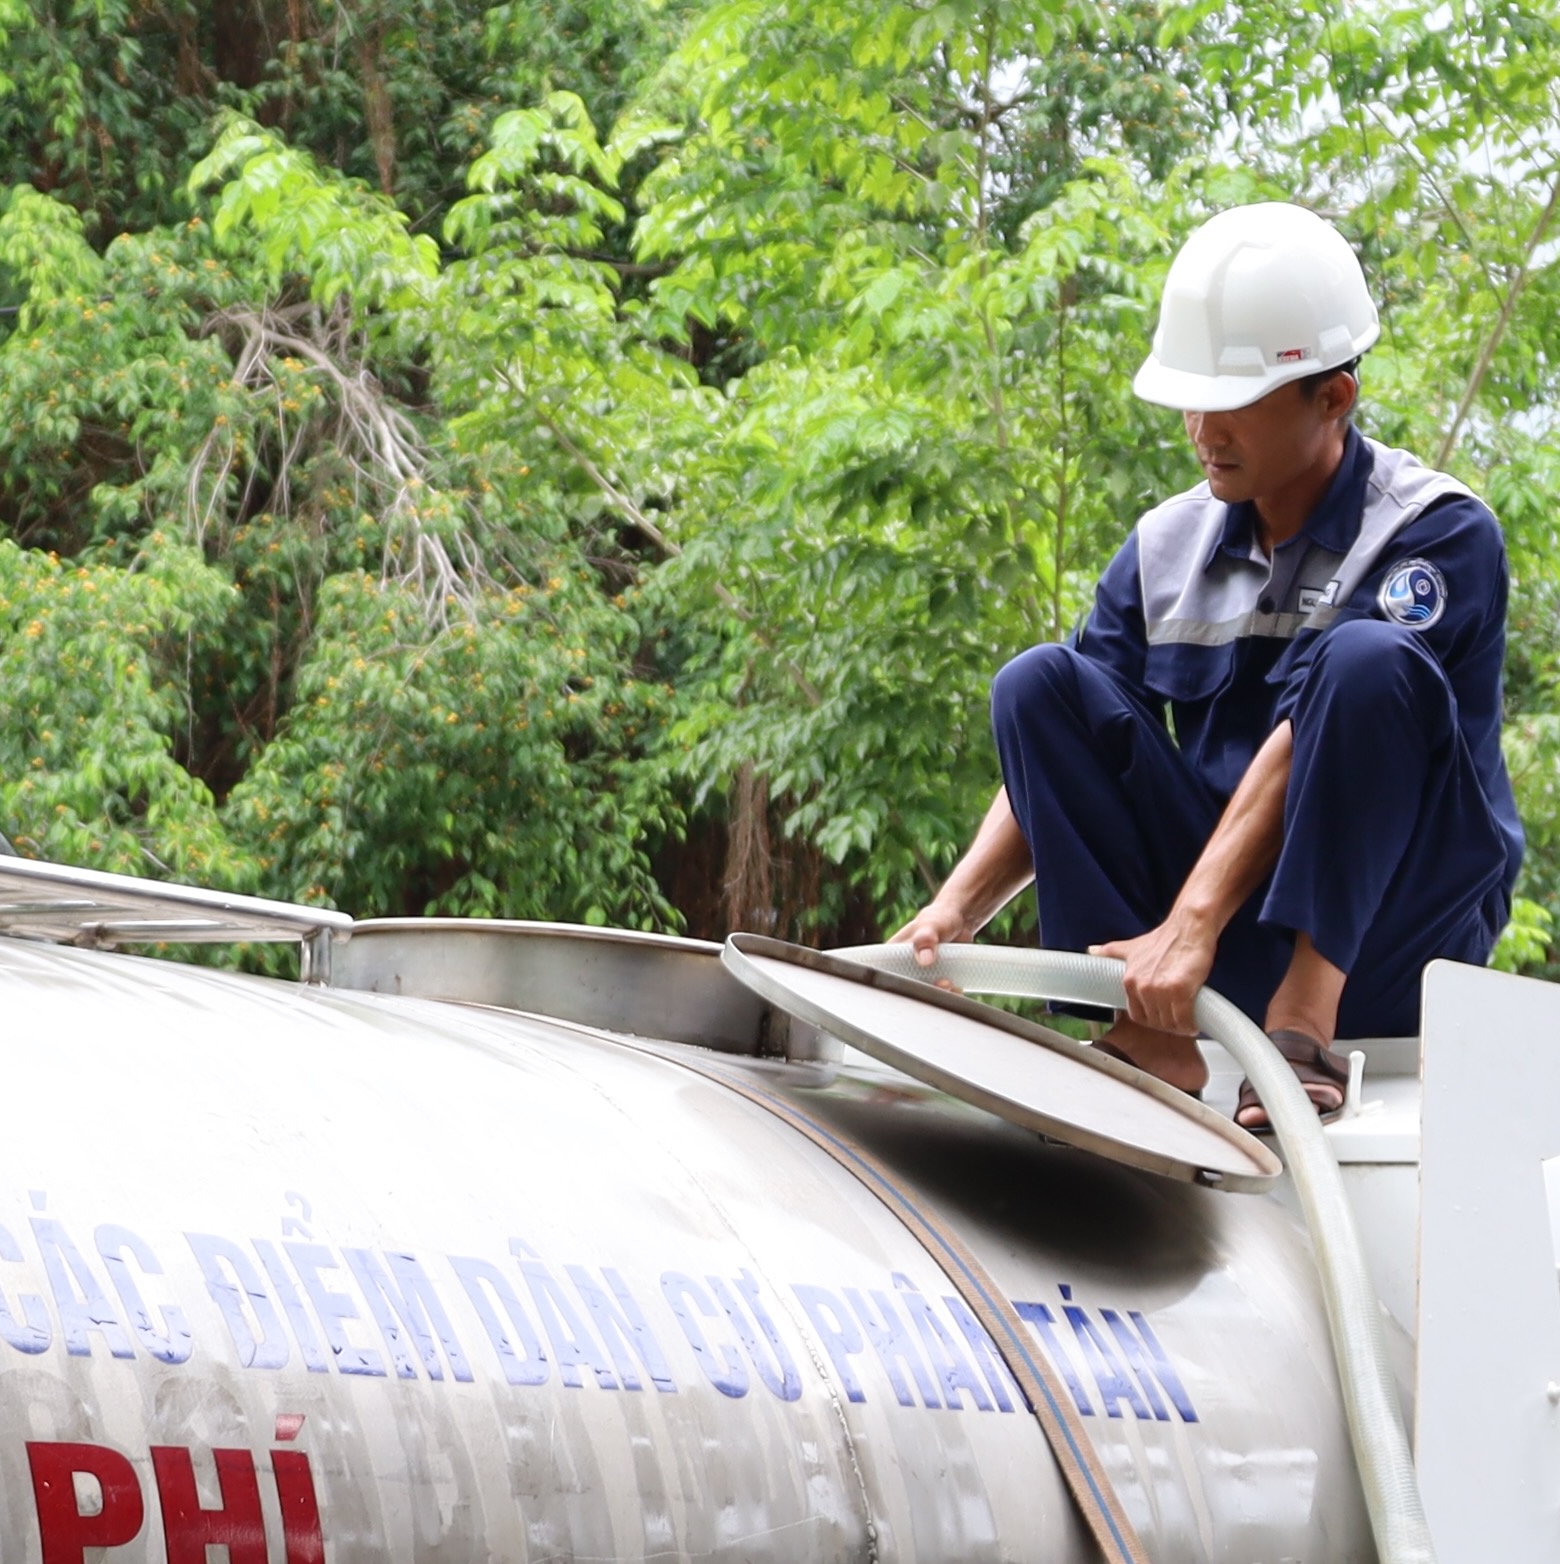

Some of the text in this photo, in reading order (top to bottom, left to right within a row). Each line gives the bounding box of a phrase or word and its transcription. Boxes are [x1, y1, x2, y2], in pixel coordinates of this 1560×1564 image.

[182, 1191, 474, 1382] ĐIỂM
[445, 1236, 678, 1393] DÂN
[659, 1266, 802, 1402] CƯ
[791, 1271, 1035, 1413] PHÂN
[1011, 1283, 1199, 1423] TÁN
